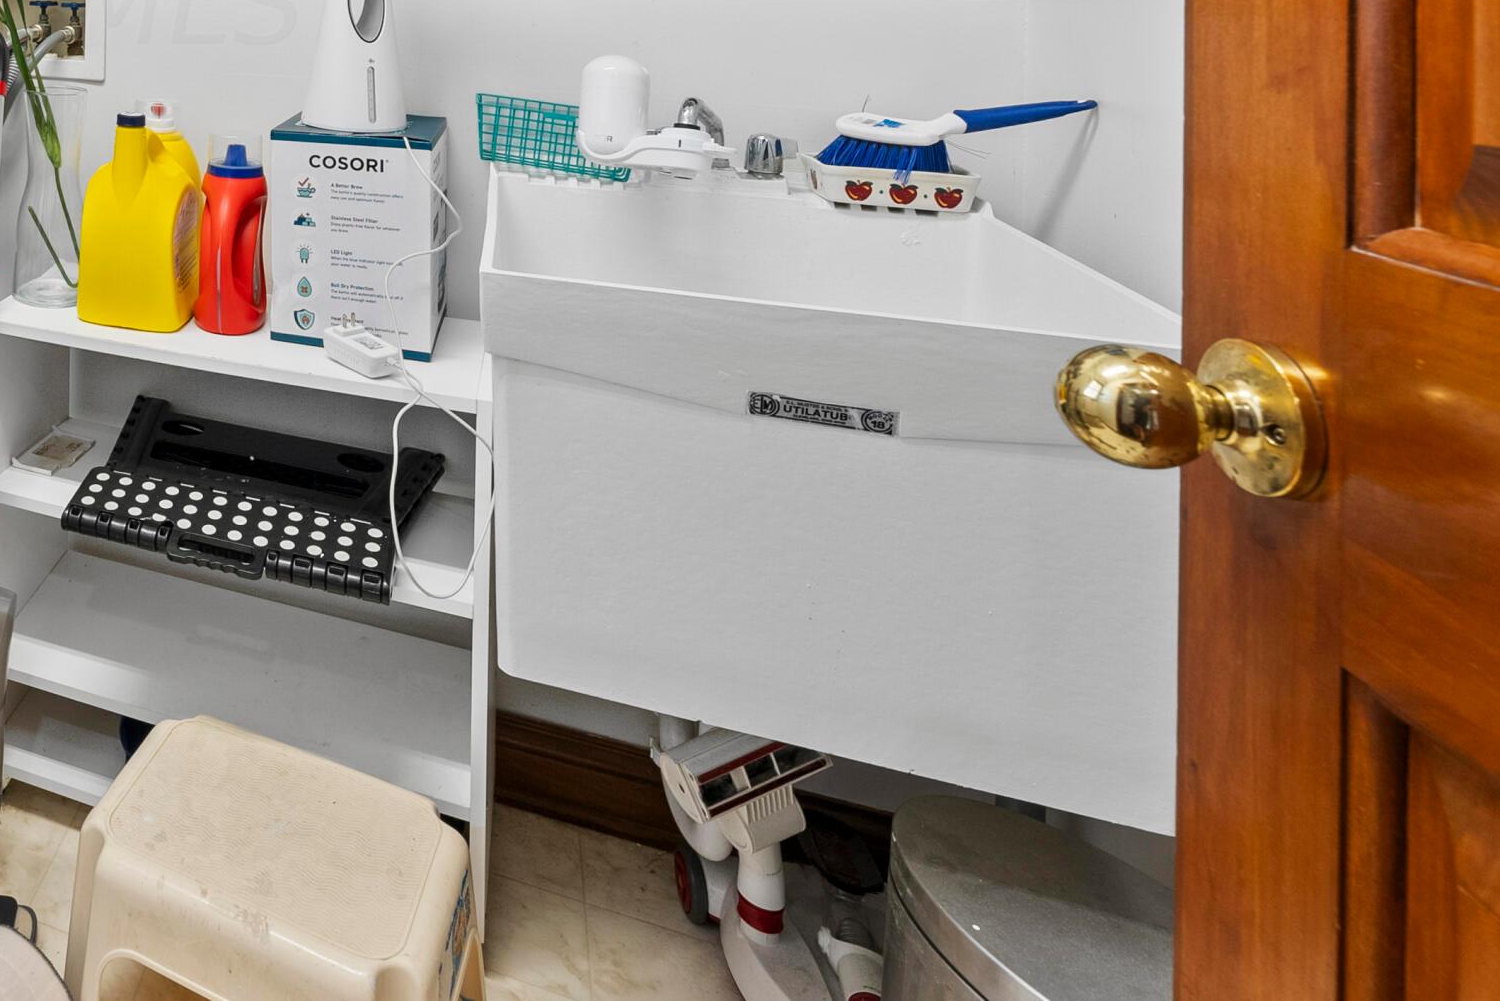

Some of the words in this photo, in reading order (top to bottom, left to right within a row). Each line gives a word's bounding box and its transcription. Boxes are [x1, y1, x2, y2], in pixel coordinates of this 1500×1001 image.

[309, 154, 384, 172] COSORI
[783, 405, 848, 421] UTILATUB
[871, 420, 885, 429] 18
